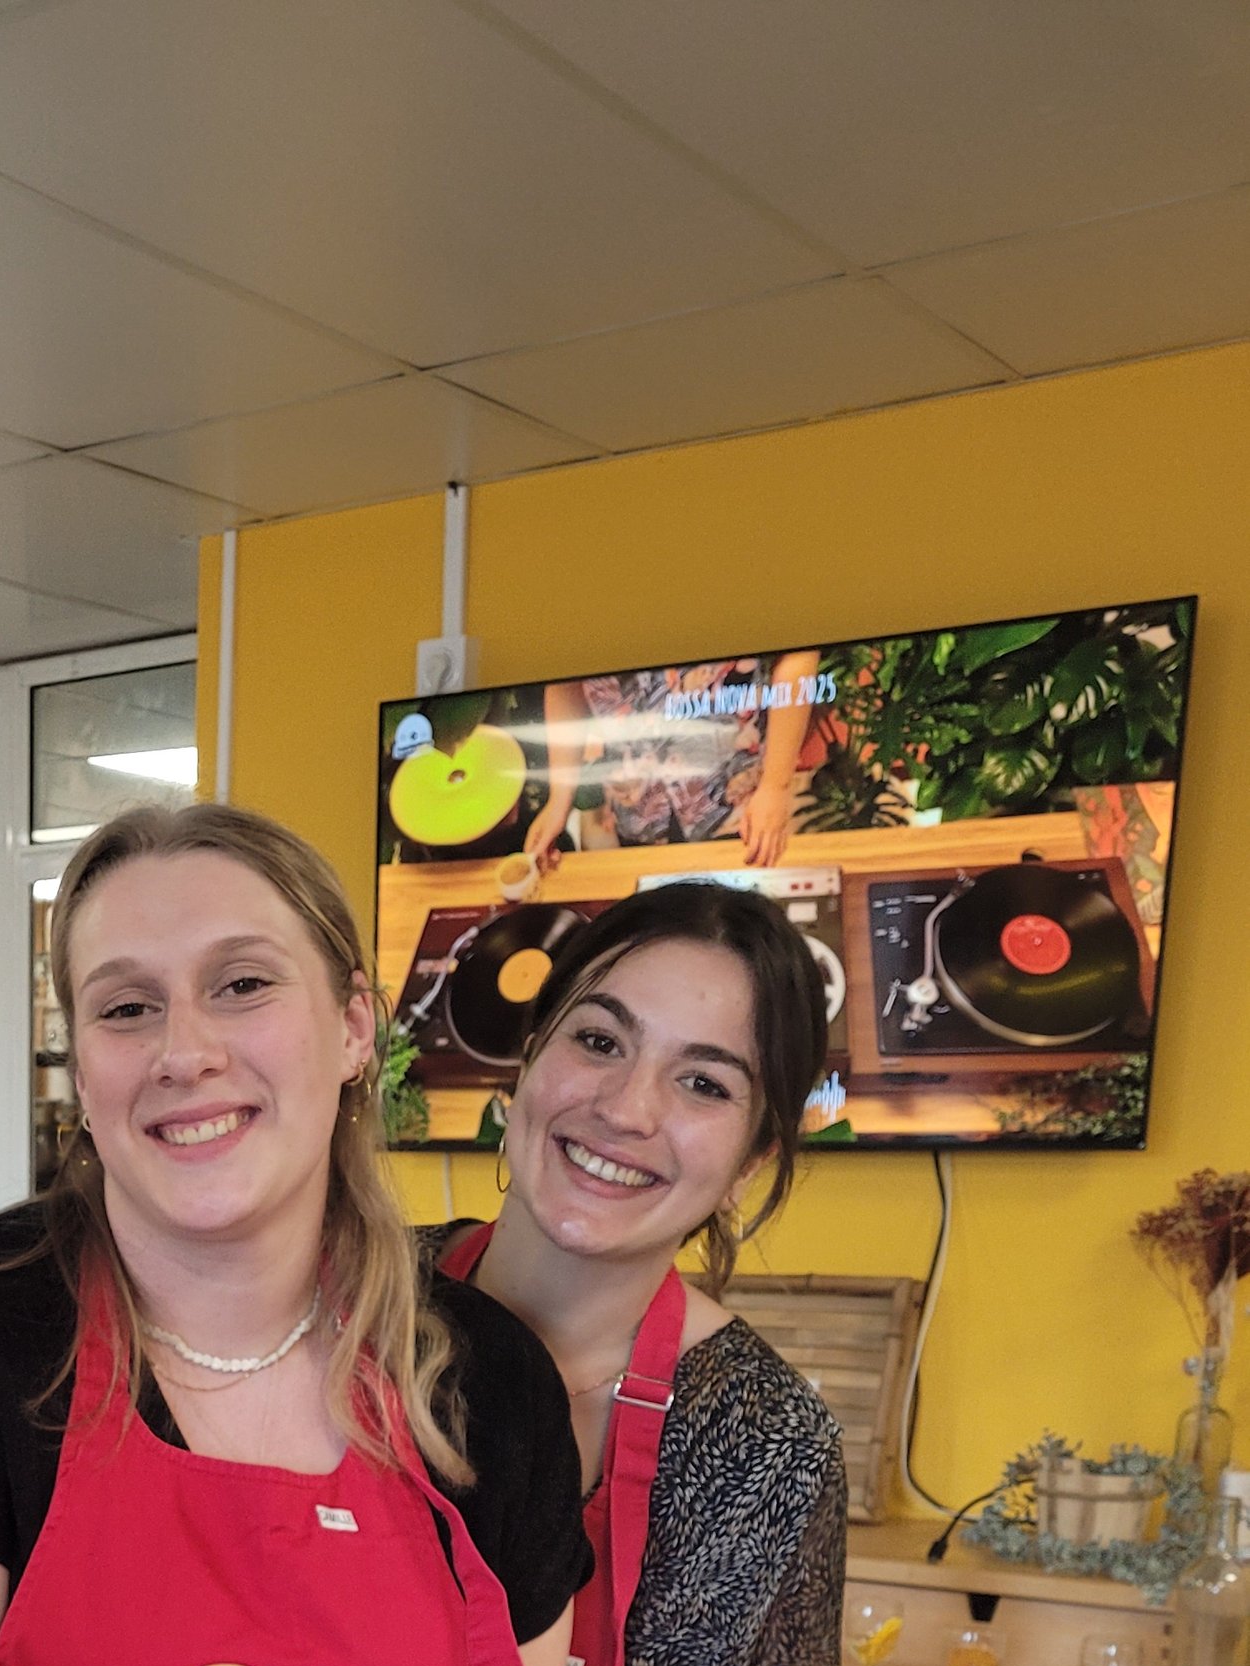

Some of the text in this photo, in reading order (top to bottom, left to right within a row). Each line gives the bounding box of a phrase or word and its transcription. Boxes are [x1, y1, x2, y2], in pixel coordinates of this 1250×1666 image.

[665, 673, 837, 721] BOSSA NOVA MIX 2025
